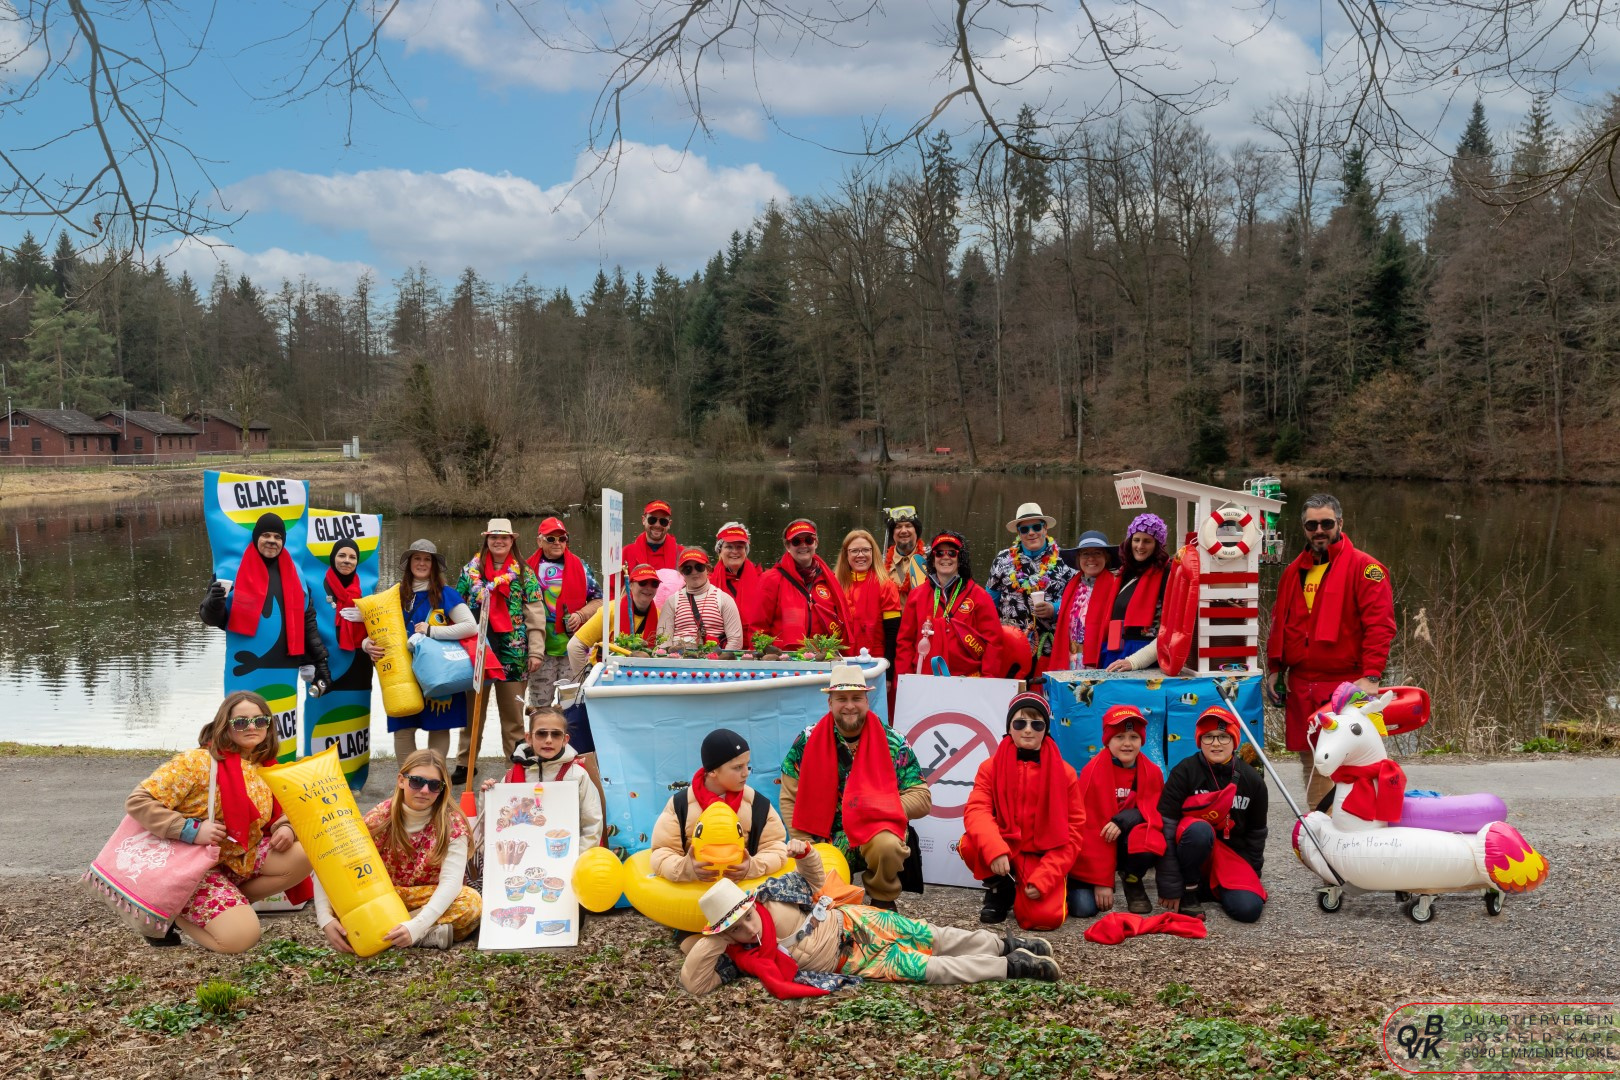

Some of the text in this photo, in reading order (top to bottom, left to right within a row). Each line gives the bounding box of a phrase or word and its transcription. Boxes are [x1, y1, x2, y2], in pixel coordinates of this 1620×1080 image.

[234, 480, 289, 508] GLACE
[315, 514, 365, 542] GLACE
[382, 662, 392, 672] 20
[303, 776, 338, 792] Louis
[299, 784, 346, 802] Widmer
[322, 809, 353, 824] All Day
[354, 864, 372, 879] 20
